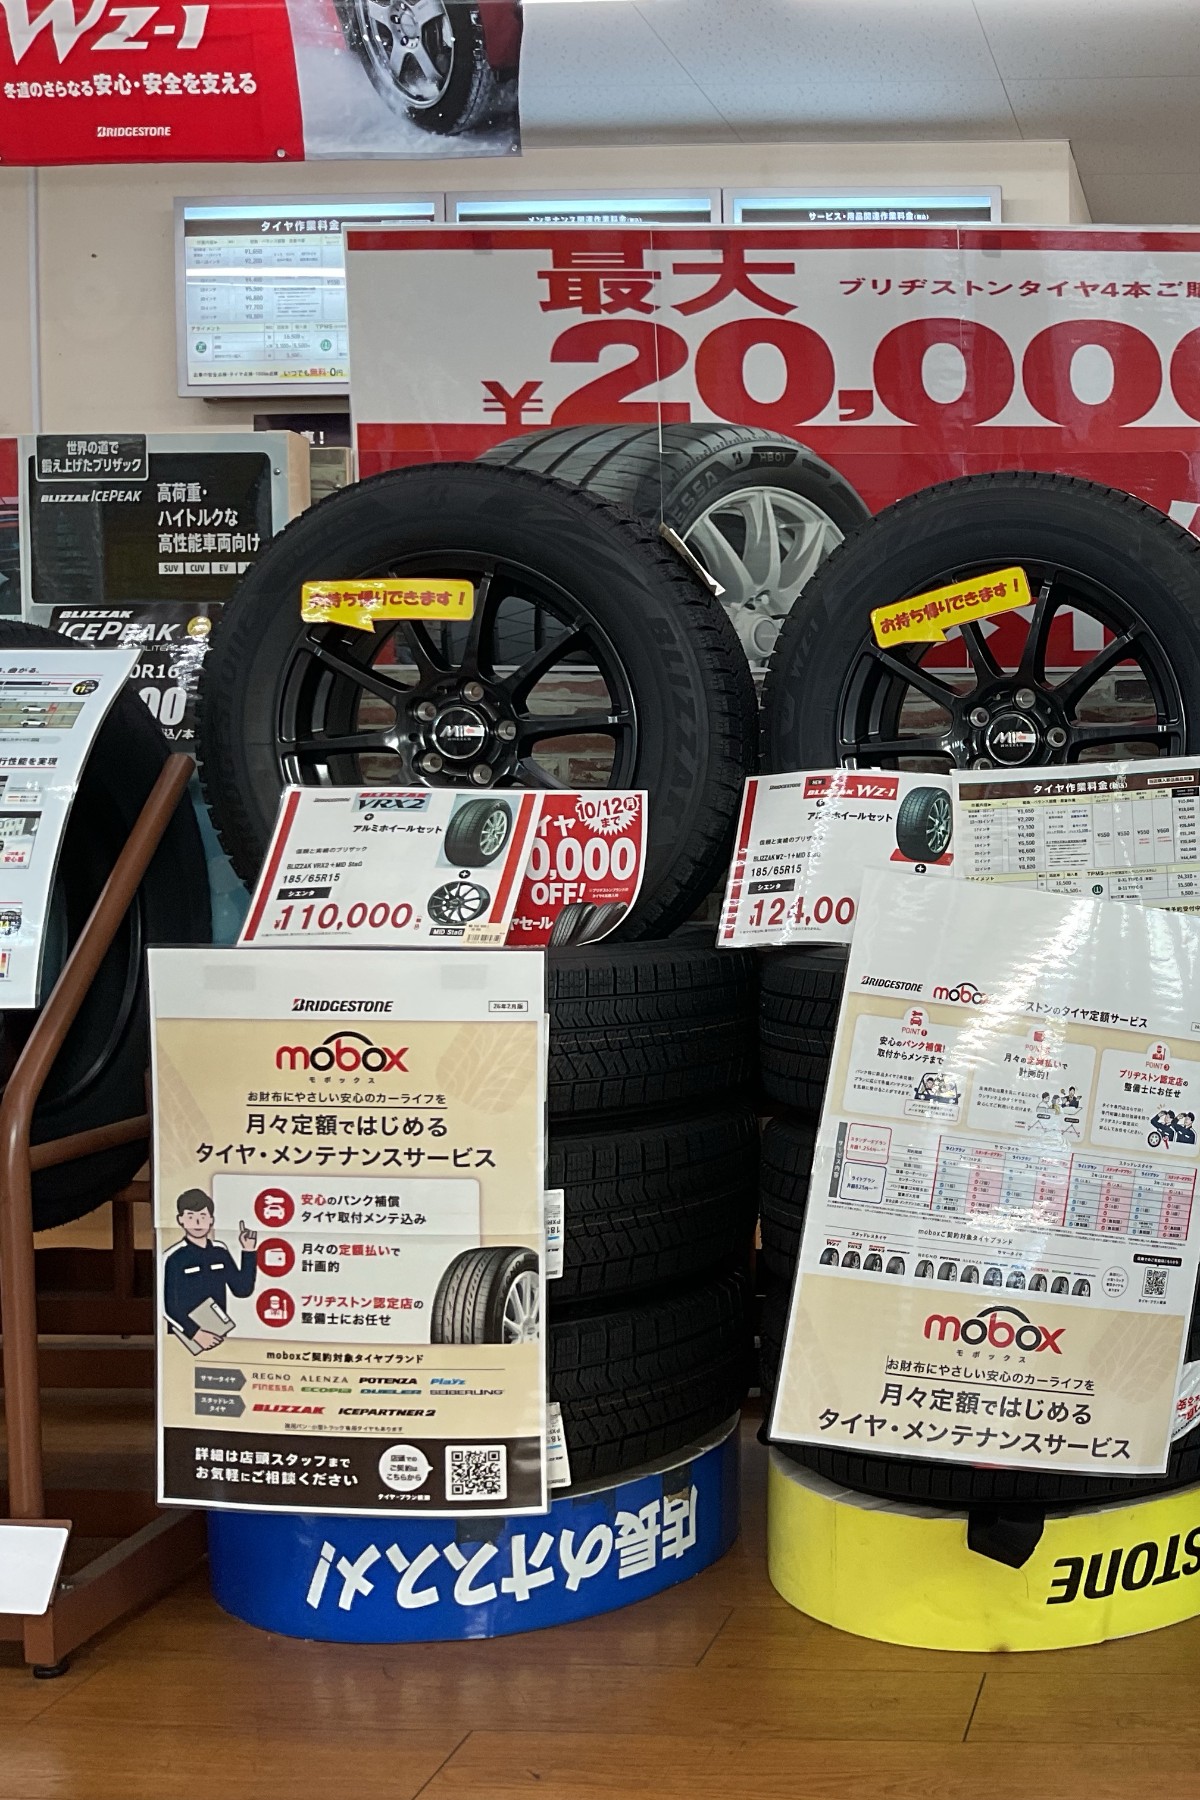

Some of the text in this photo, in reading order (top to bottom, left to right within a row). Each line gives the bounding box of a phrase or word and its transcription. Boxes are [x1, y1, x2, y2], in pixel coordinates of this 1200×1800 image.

[4, 72, 257, 98] 冬道のさらなる安心・安全を支える
[97, 127, 171, 137] BRIDGESTONE
[261, 220, 340, 232] タイヤ作業料金
[537, 249, 797, 316] 最大
[66, 440, 119, 455] 世界の道で
[41, 457, 142, 474] 鍛え上げたブリザック
[40, 489, 142, 503] BLIZZAK ICEPEAK
[157, 508, 238, 527] ハイトルクな
[157, 533, 261, 553] 高性能車両向け
[164, 563, 228, 572] SUV CUV EV
[59, 610, 134, 619] BLIZZAK
[879, 578, 1021, 636] お持ち帰りできます!
[856, 785, 895, 797] WZ-1
[359, 799, 427, 810] VRX2
[576, 797, 623, 822] 10/12
[353, 824, 443, 833] アルミホイールセット
[601, 816, 620, 828] まで
[283, 873, 340, 883] 185/65R15
[751, 864, 802, 877] 185/65R15
[531, 882, 586, 905] OFF!
[758, 883, 781, 891] シエンタ
[274, 903, 413, 930] ¥110,000
[291, 998, 394, 1013] BRIDGESTONE
[860, 975, 1148, 1029] BRIDGESTONE ストンのタイヤ定額サービス
[275, 1035, 409, 1073] mobox
[877, 1048, 944, 1064] 取付からメンテまで
[1146, 1061, 1163, 1069] POINT
[308, 1076, 376, 1085] モボックス
[1119, 1069, 1189, 1087] ブリヂストン認定店の
[247, 1091, 447, 1105] お財布にやさしい安心のカーライフを
[1124, 1083, 1181, 1098] 整備士にお任せ
[245, 1113, 448, 1138] 月々定額ではじめる
[195, 1142, 497, 1168] タイヤ・メンテナンスサービス
[852, 1175, 875, 1183] ライトプラン
[300, 1210, 427, 1225] タイヤ取付メンテ込み
[302, 1243, 401, 1257] 月々の定額払いで
[301, 1259, 340, 1274] 計画的
[300, 1294, 423, 1311] ブリヂストン認定店の
[300, 1312, 392, 1327] 整備士にお任せ
[923, 1309, 1066, 1355] mobox
[266, 1350, 424, 1365] moboxご契約対象タイヤブランド
[956, 1349, 1026, 1364] モボックス
[200, 1372, 418, 1385] サマータイヤ REGNO ALENZA POTENZA
[887, 1358, 1095, 1391] お財布にやさしい安心のカーライフを
[252, 1384, 294, 1392] FINESSA
[252, 1404, 326, 1414] BLIZZAK
[880, 1383, 1092, 1425] 月々定額ではじめる
[818, 1408, 1131, 1459] タイヤ・メンテナンスサービス
[195, 1447, 351, 1469] 詳細は店頭スタッフまで
[195, 1466, 358, 1487] お気軽にご相談ください
[386, 1472, 422, 1482] こちらから
[305, 1483, 699, 1611] 店長のオススメ!
